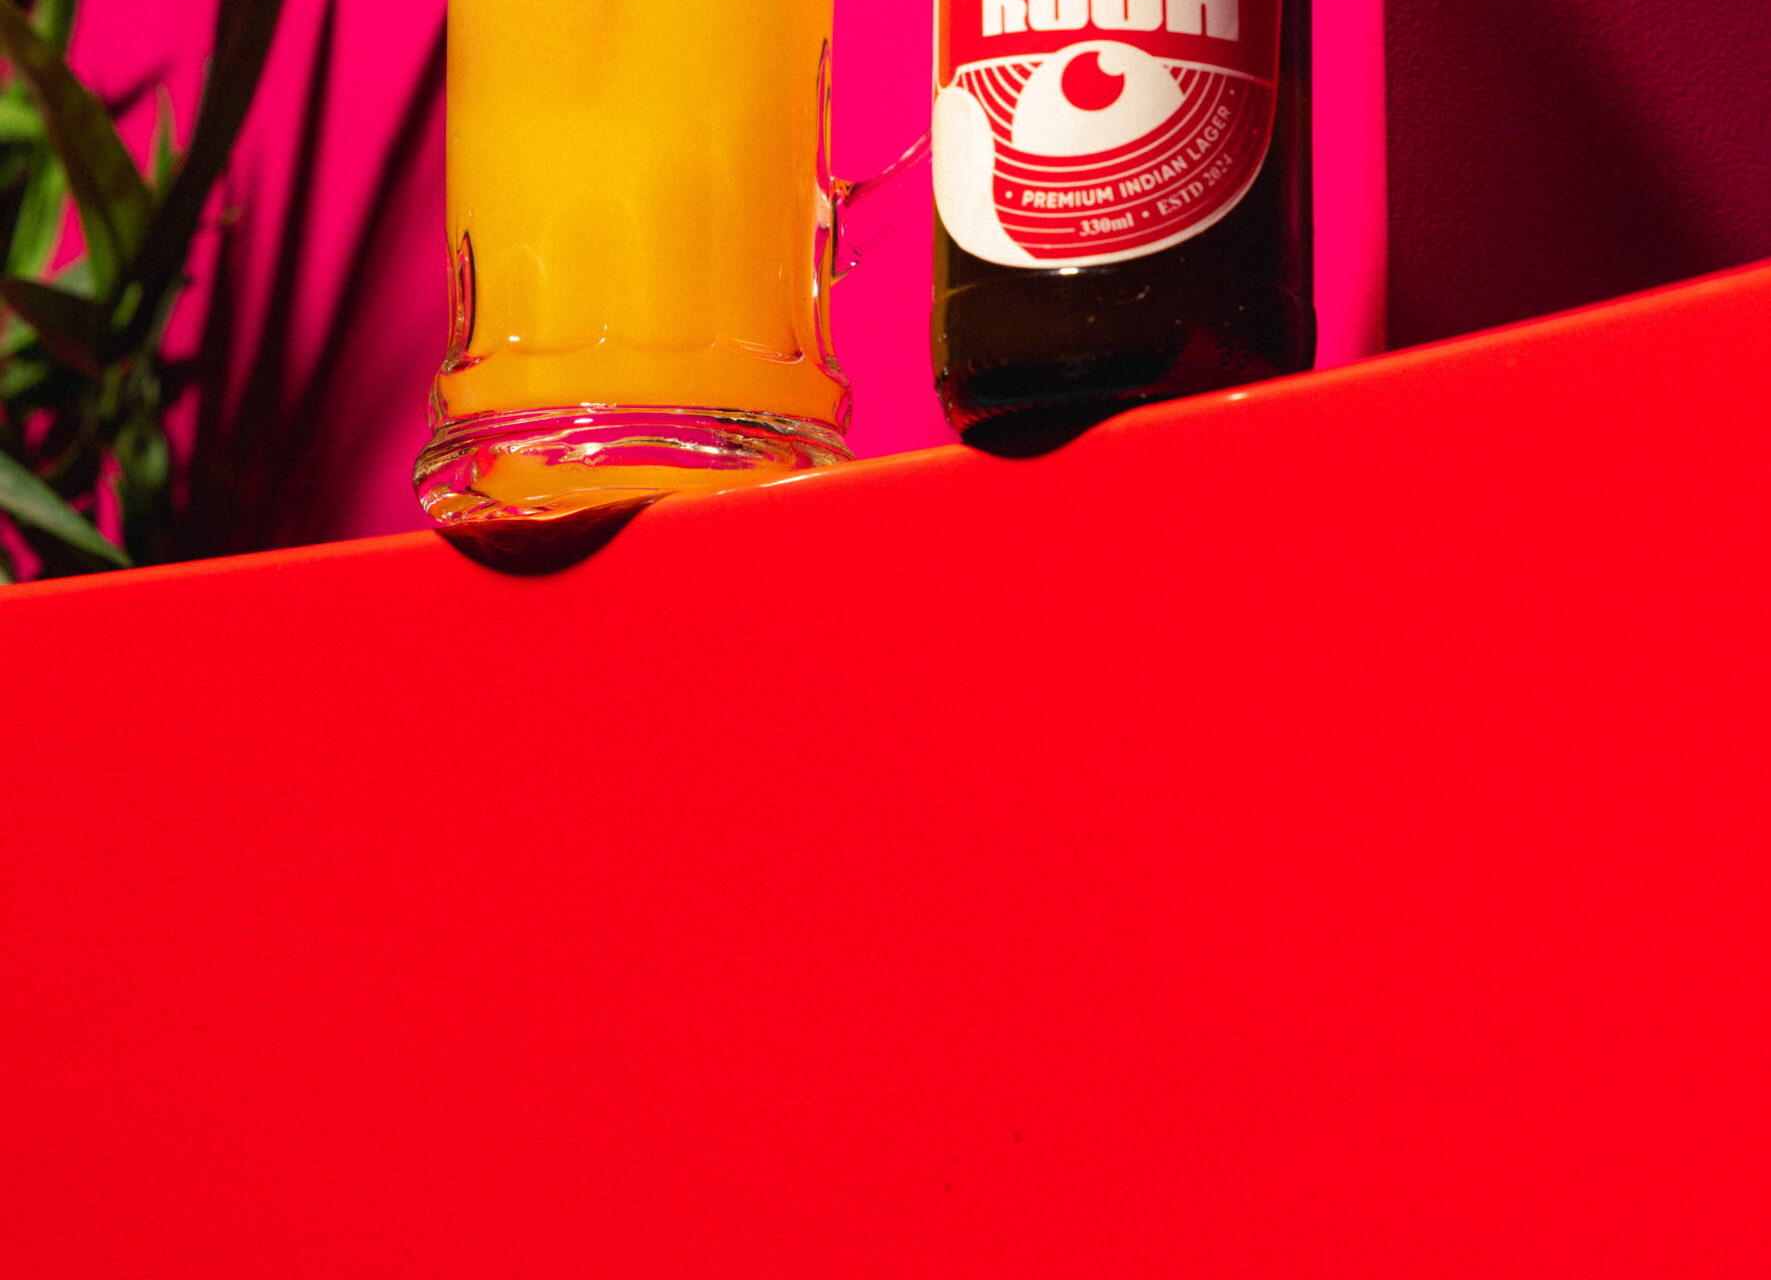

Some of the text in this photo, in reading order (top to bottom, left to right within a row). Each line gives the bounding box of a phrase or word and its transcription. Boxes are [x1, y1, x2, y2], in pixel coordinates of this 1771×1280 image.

[1021, 104, 1231, 209] PREMIUM INDIAN LAGER
[1079, 212, 1134, 237] 330ml
[1157, 181, 1204, 216] ESTD
